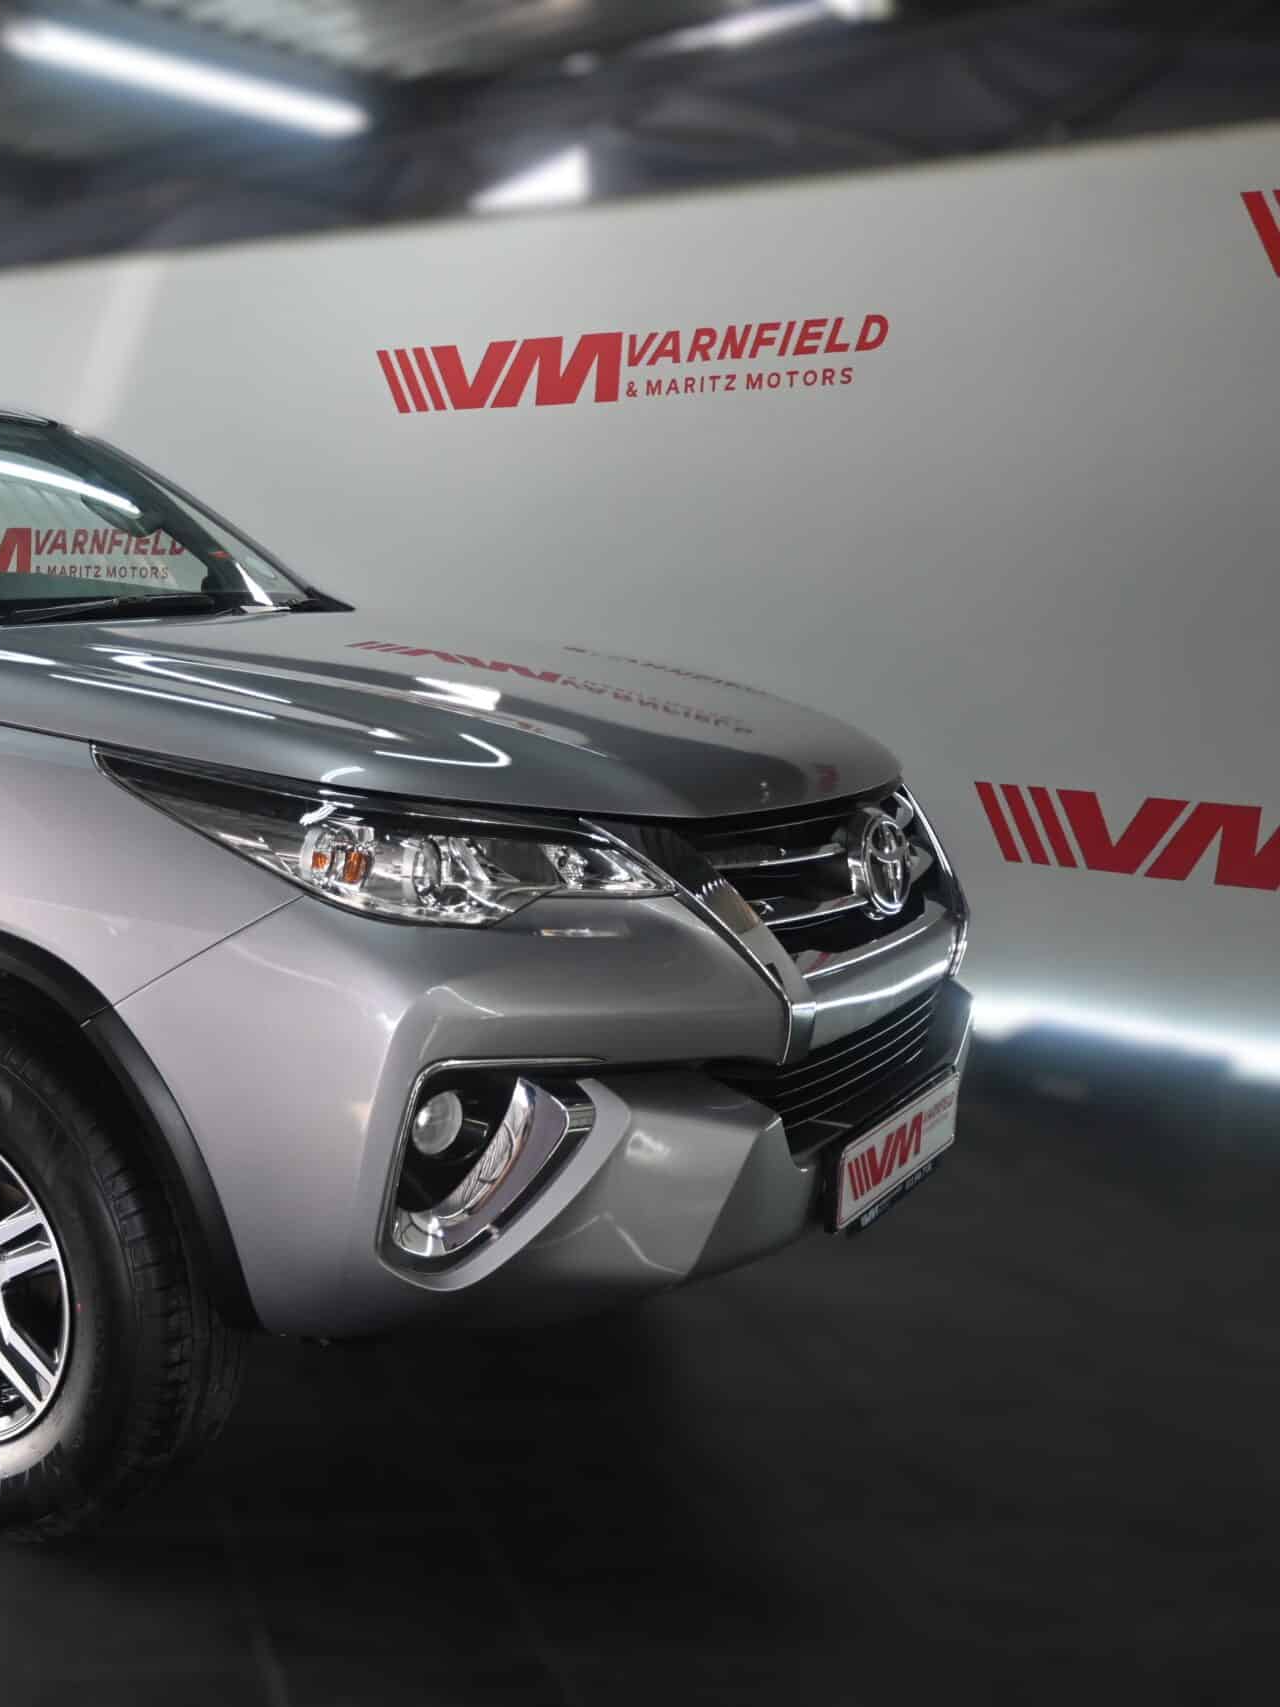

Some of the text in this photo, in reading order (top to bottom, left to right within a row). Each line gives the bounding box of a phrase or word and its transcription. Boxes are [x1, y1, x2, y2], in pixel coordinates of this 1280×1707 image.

[625, 314, 889, 368] VARNFIELD
[430, 331, 624, 411] VM
[625, 367, 854, 398] & MARITZ MOTORS
[47, 564, 101, 578] MARITZ
[106, 565, 169, 580] MOTORS
